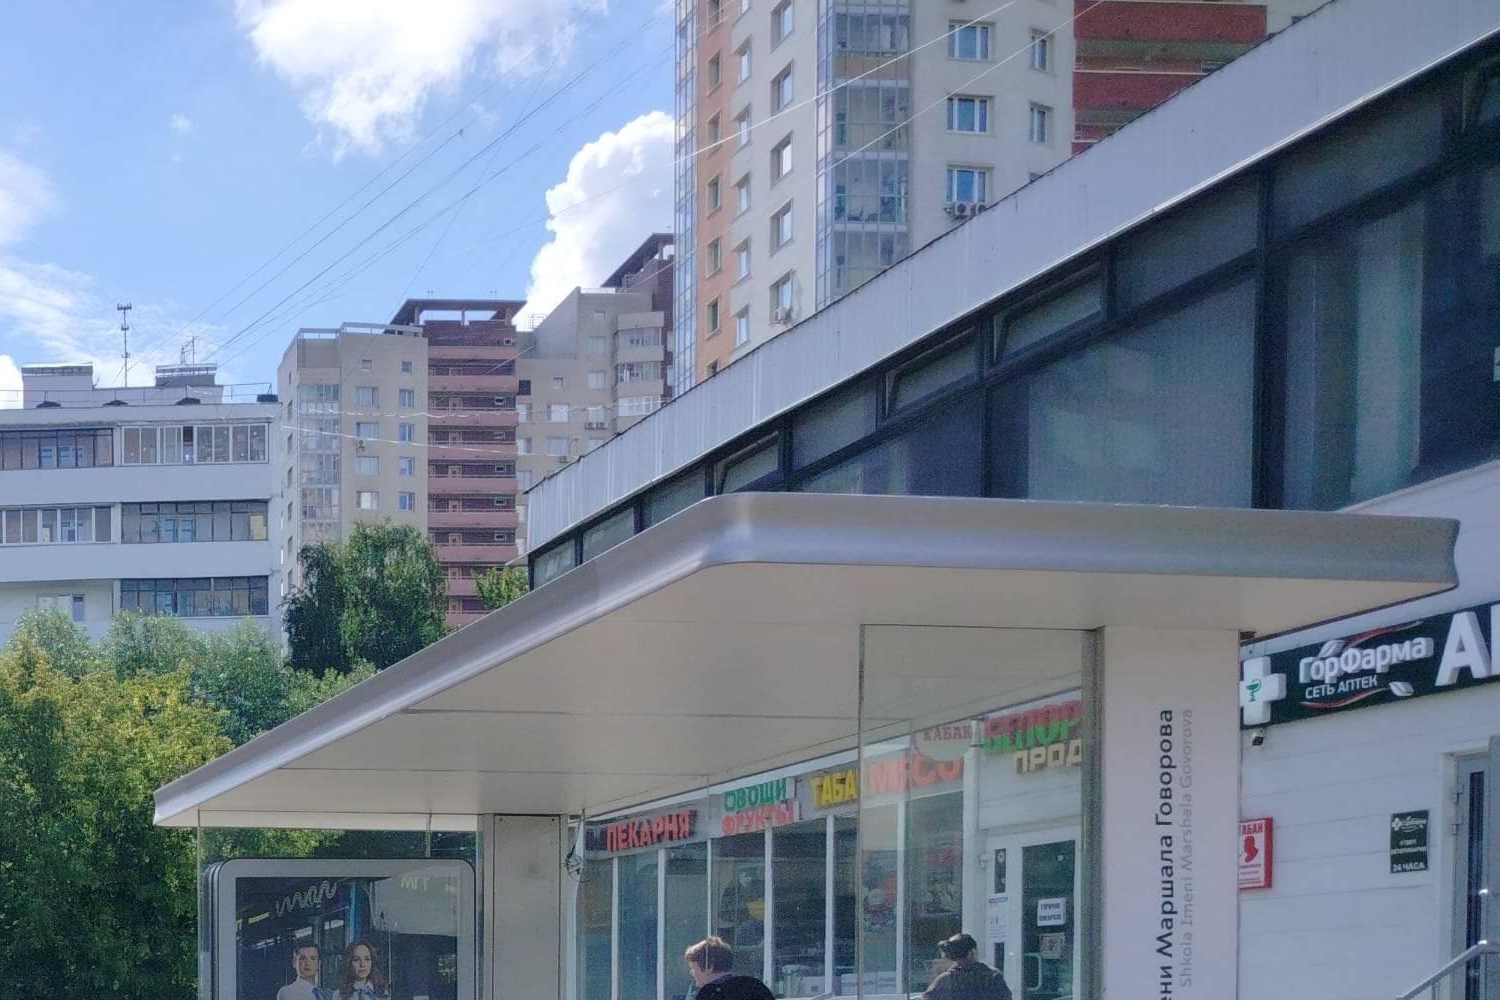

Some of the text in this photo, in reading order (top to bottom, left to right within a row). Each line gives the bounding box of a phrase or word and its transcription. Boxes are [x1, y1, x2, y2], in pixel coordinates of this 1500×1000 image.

[1299, 637, 1433, 684] ГорФарма
[1435, 603, 1500, 687] А
[1305, 675, 1378, 699] СЕТЬ АПТЕК
[1156, 709, 1177, 826] Говорова
[1180, 709, 1193, 789] Govorova
[722, 801, 794, 835] ФРУКТЫ
[724, 777, 788, 812] ОВОЩИ
[605, 810, 693, 851] ПЕКАРНЯ
[1180, 793, 1193, 871] Marshala
[1156, 835, 1177, 958] Маршала
[1180, 931, 1193, 988] Shkola
